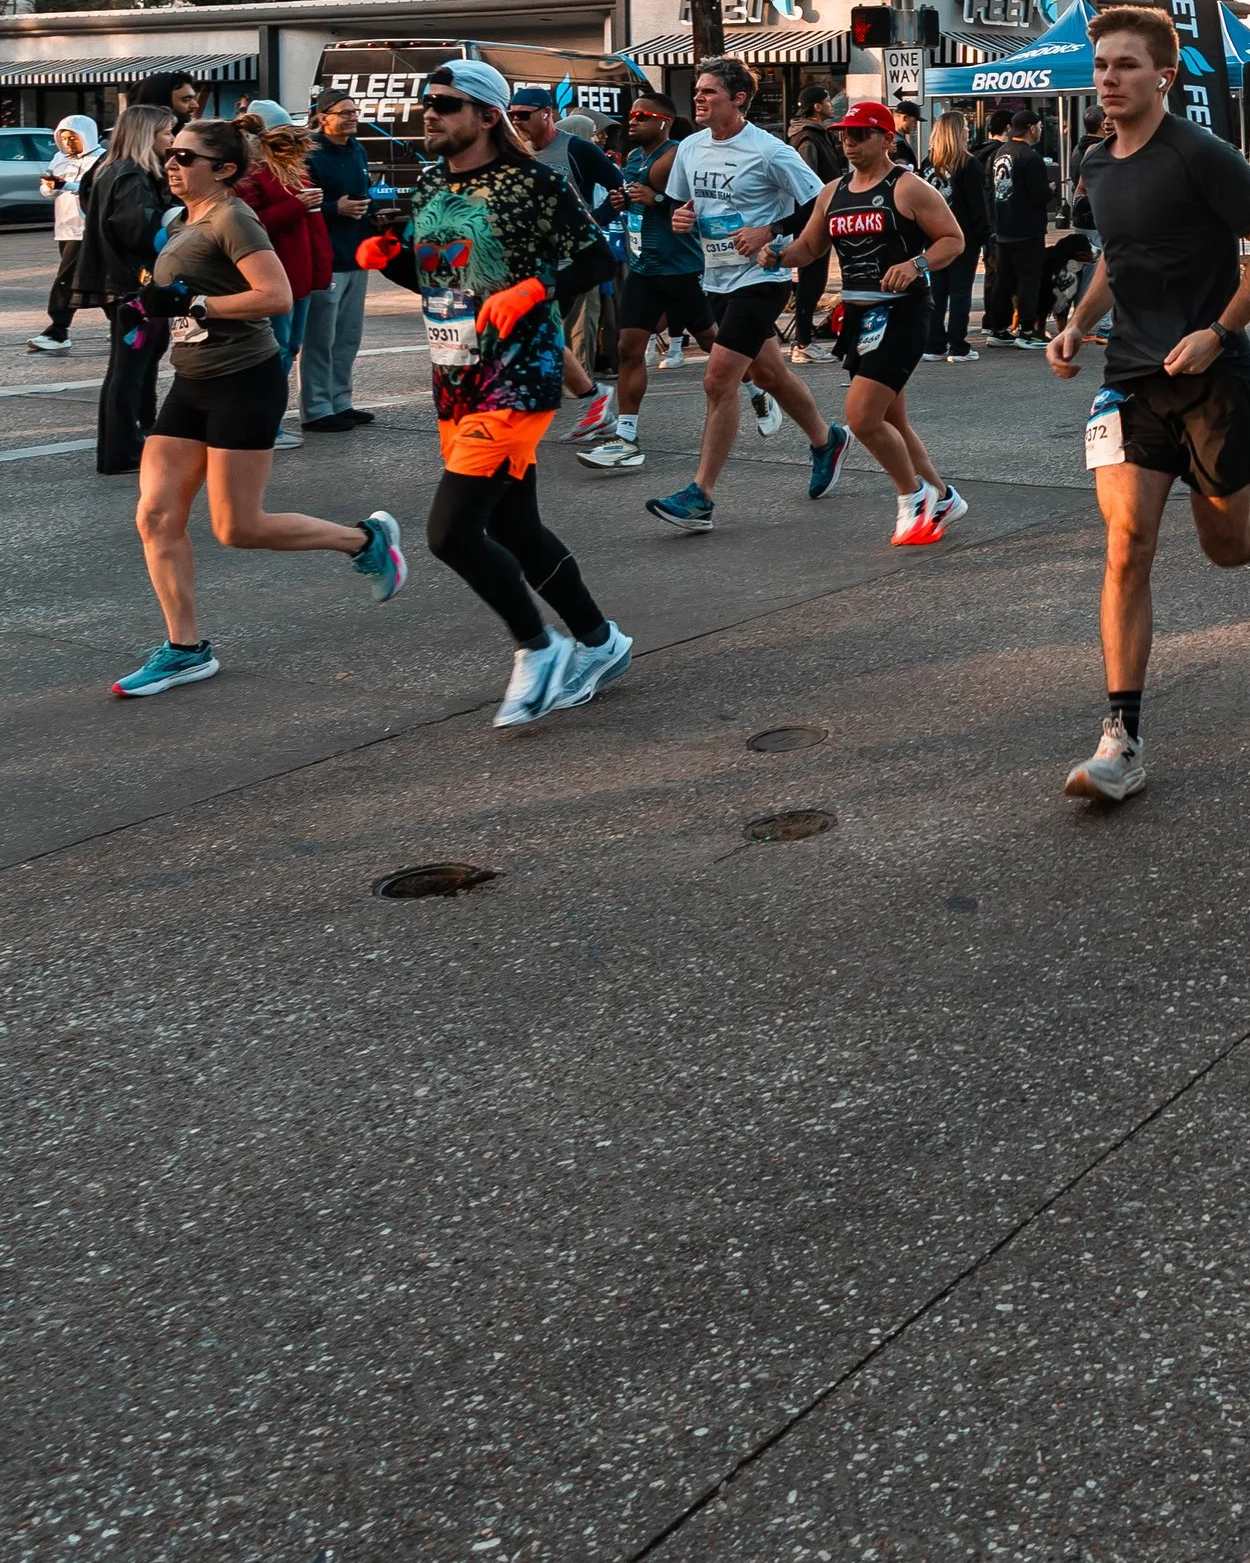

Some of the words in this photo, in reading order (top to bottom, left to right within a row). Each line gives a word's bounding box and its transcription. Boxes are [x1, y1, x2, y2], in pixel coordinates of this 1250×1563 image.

[889, 52, 919, 67] ONE
[331, 73, 428, 98] FLEET
[890, 69, 920, 84] WAY
[971, 69, 1052, 91] BROOKS
[354, 98, 418, 123] EET
[577, 86, 621, 113] FEET
[693, 171, 735, 191] HTX
[829, 213, 883, 236] FREAKS
